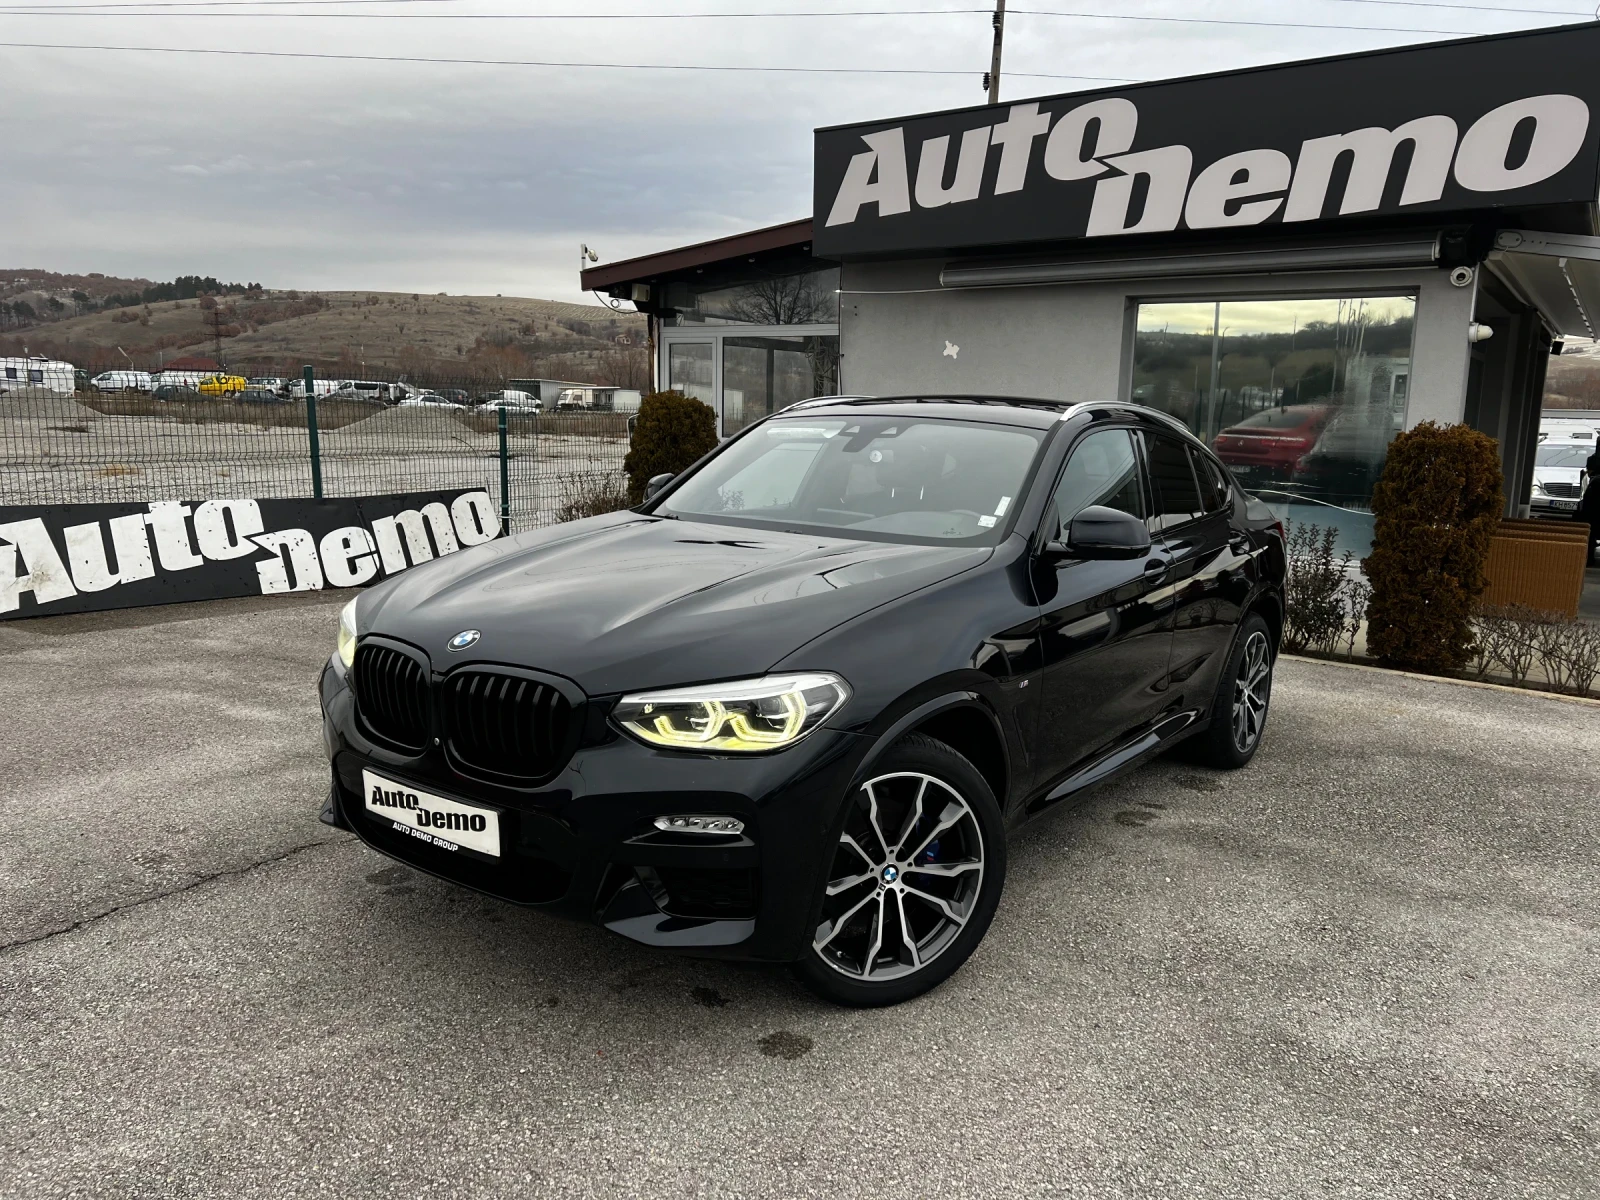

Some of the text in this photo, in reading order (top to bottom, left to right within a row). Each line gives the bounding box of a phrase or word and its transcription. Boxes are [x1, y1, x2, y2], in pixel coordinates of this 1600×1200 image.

[825, 98, 1138, 227] Auto
[1086, 94, 1589, 237] Demo
[0, 499, 264, 613] Auto
[255, 491, 501, 594] Demo
[372, 785, 419, 810] Auto
[392, 821, 459, 852] AUTO DEMO GROUP
[416, 807, 486, 832] Demo
